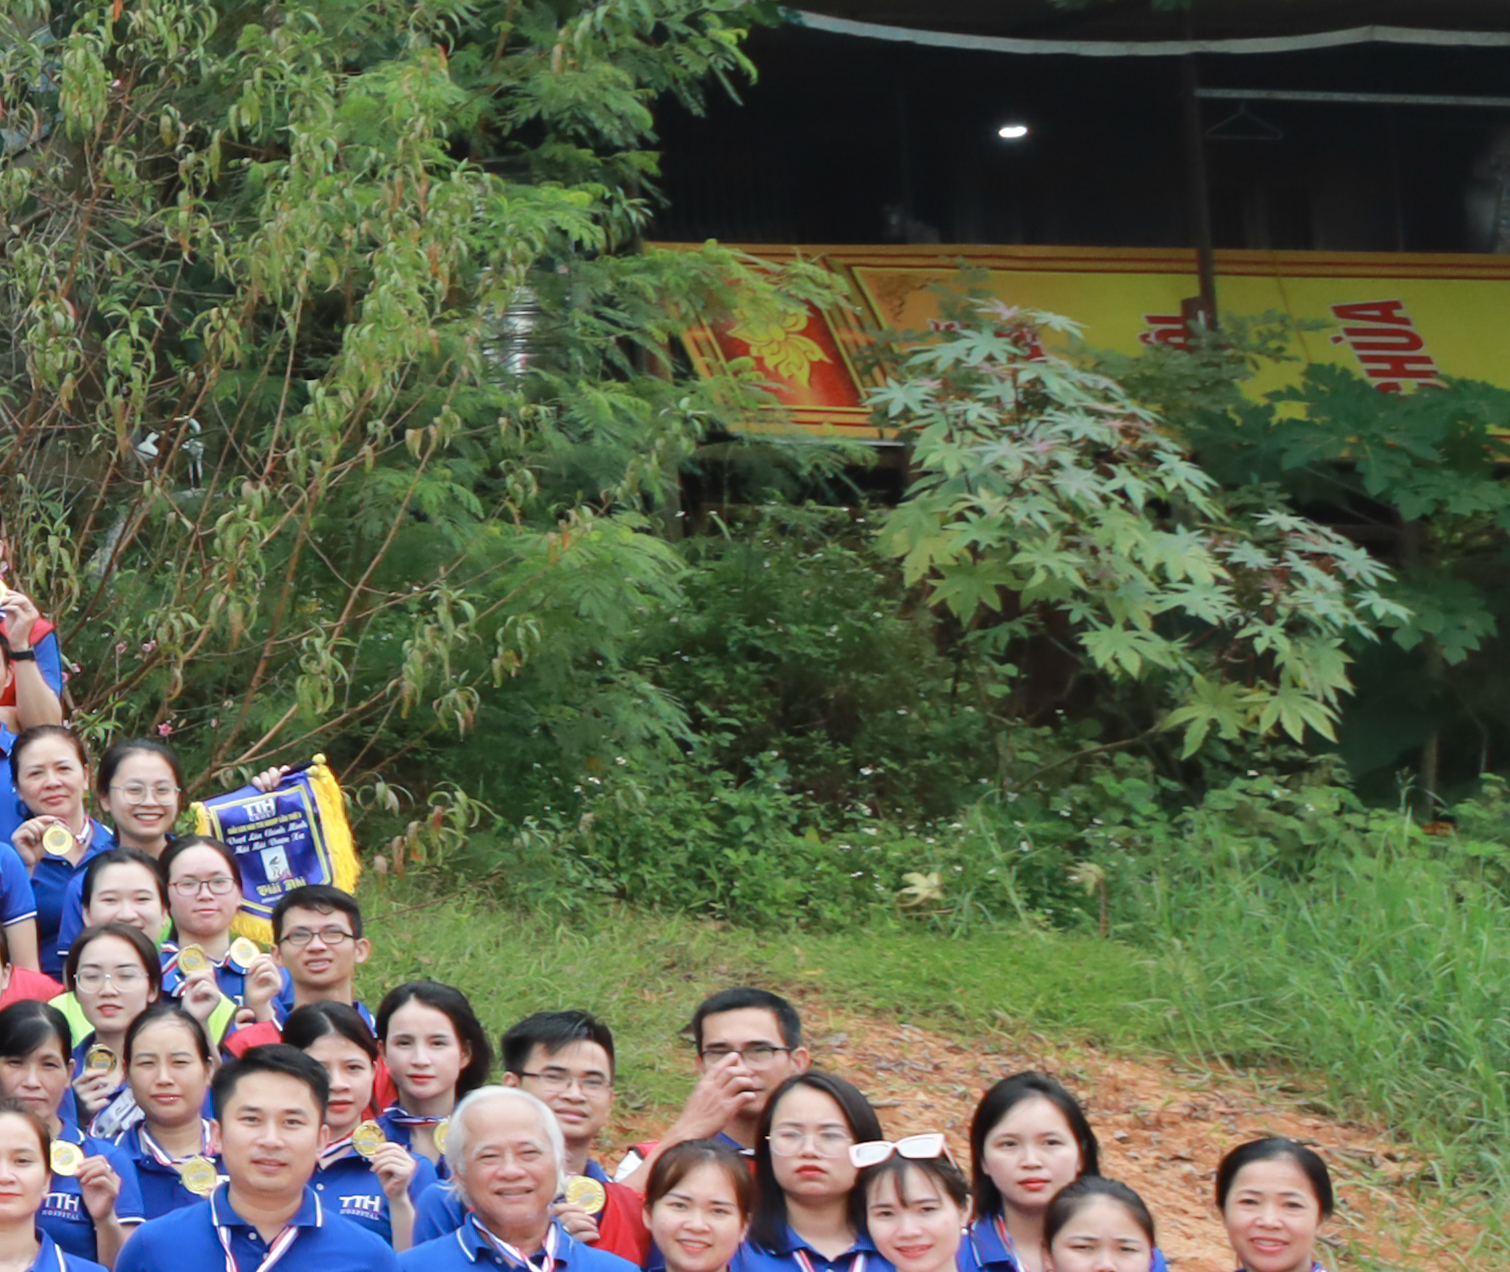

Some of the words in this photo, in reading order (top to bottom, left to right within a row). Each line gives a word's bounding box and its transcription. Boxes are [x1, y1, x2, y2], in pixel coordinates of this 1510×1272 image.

[45, 1193, 80, 1211] TTH
[339, 1195, 381, 1212] TTH
[41, 1210, 80, 1220] HOSPITAL
[339, 1209, 380, 1220] HOSPITAL
